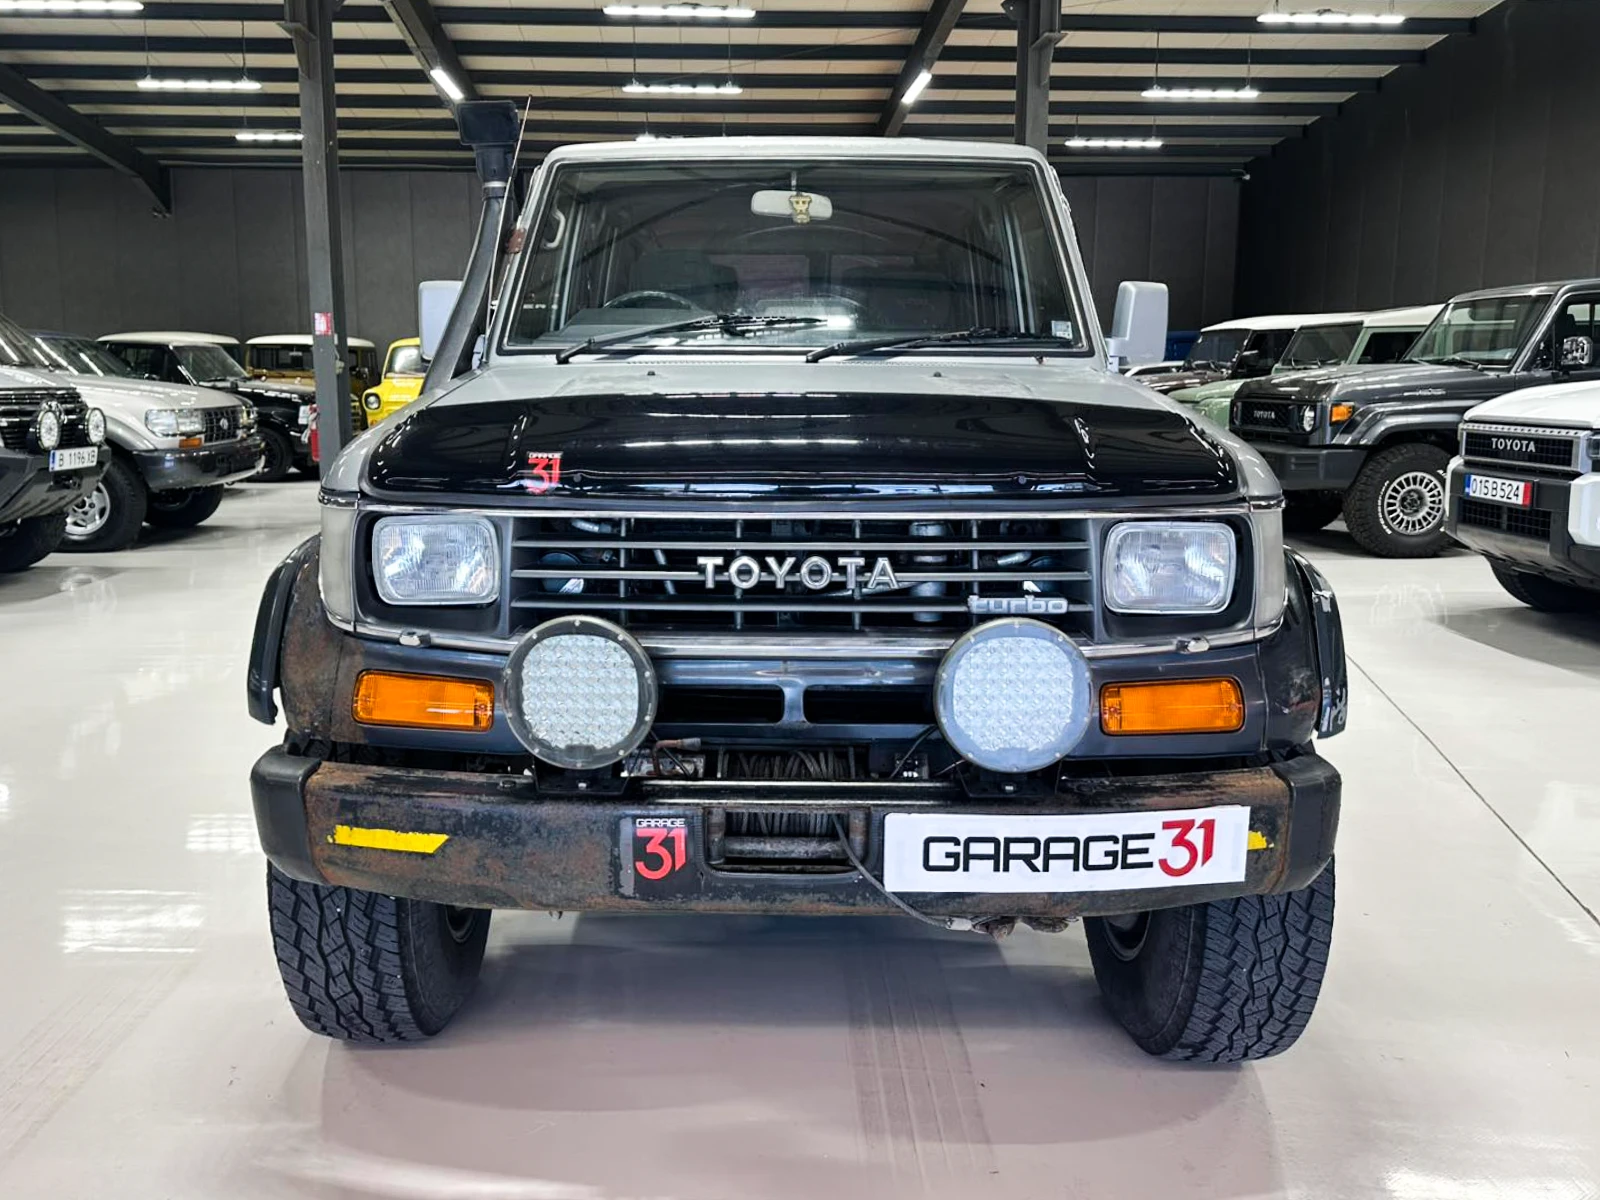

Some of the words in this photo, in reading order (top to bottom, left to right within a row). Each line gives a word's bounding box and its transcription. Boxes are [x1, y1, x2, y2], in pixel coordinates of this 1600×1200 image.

[1253, 410, 1276, 420] TOYOTA
[1491, 438, 1536, 453] TOYOTA
[59, 453, 64, 467] B
[528, 458, 560, 495] 31
[697, 555, 899, 589] TOYOTA
[967, 594, 1068, 614] turbo
[635, 818, 686, 828] GARAGE
[635, 827, 687, 880] 31
